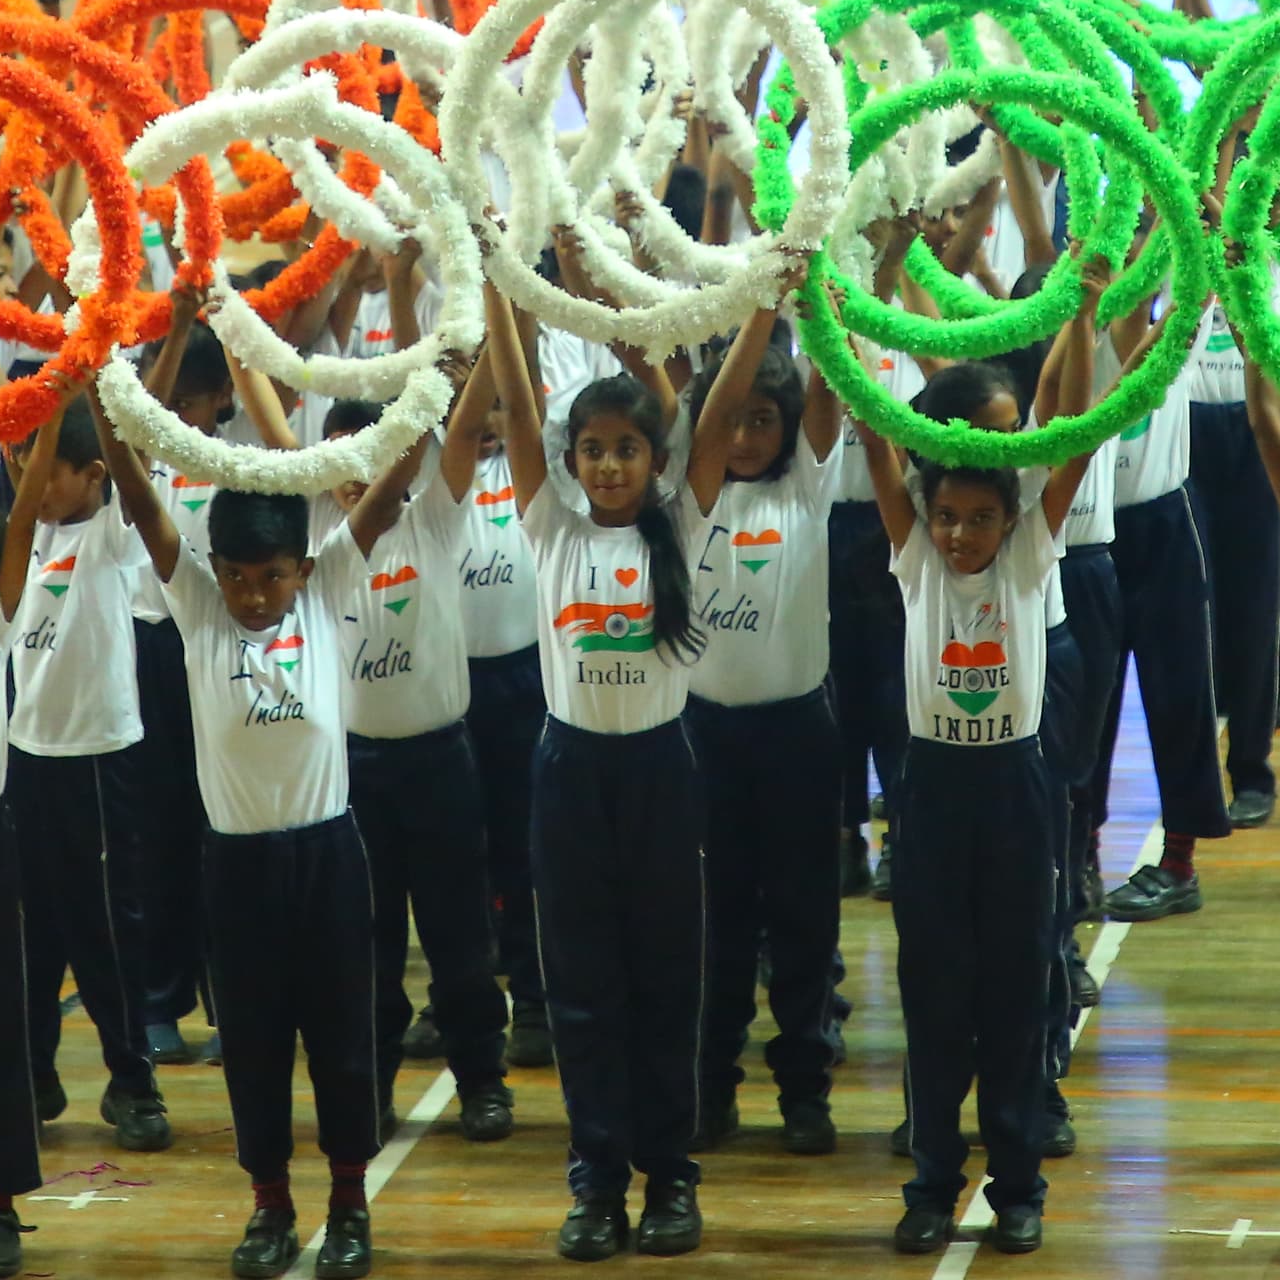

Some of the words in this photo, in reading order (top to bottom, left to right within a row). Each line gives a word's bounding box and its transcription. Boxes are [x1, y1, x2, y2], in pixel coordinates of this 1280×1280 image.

[459, 548, 514, 588] India
[587, 566, 598, 591] I
[699, 587, 760, 632] India
[230, 640, 256, 680] I
[350, 638, 414, 681] India
[576, 660, 647, 686] India
[245, 690, 305, 727] India
[934, 714, 1014, 742] INDIA
